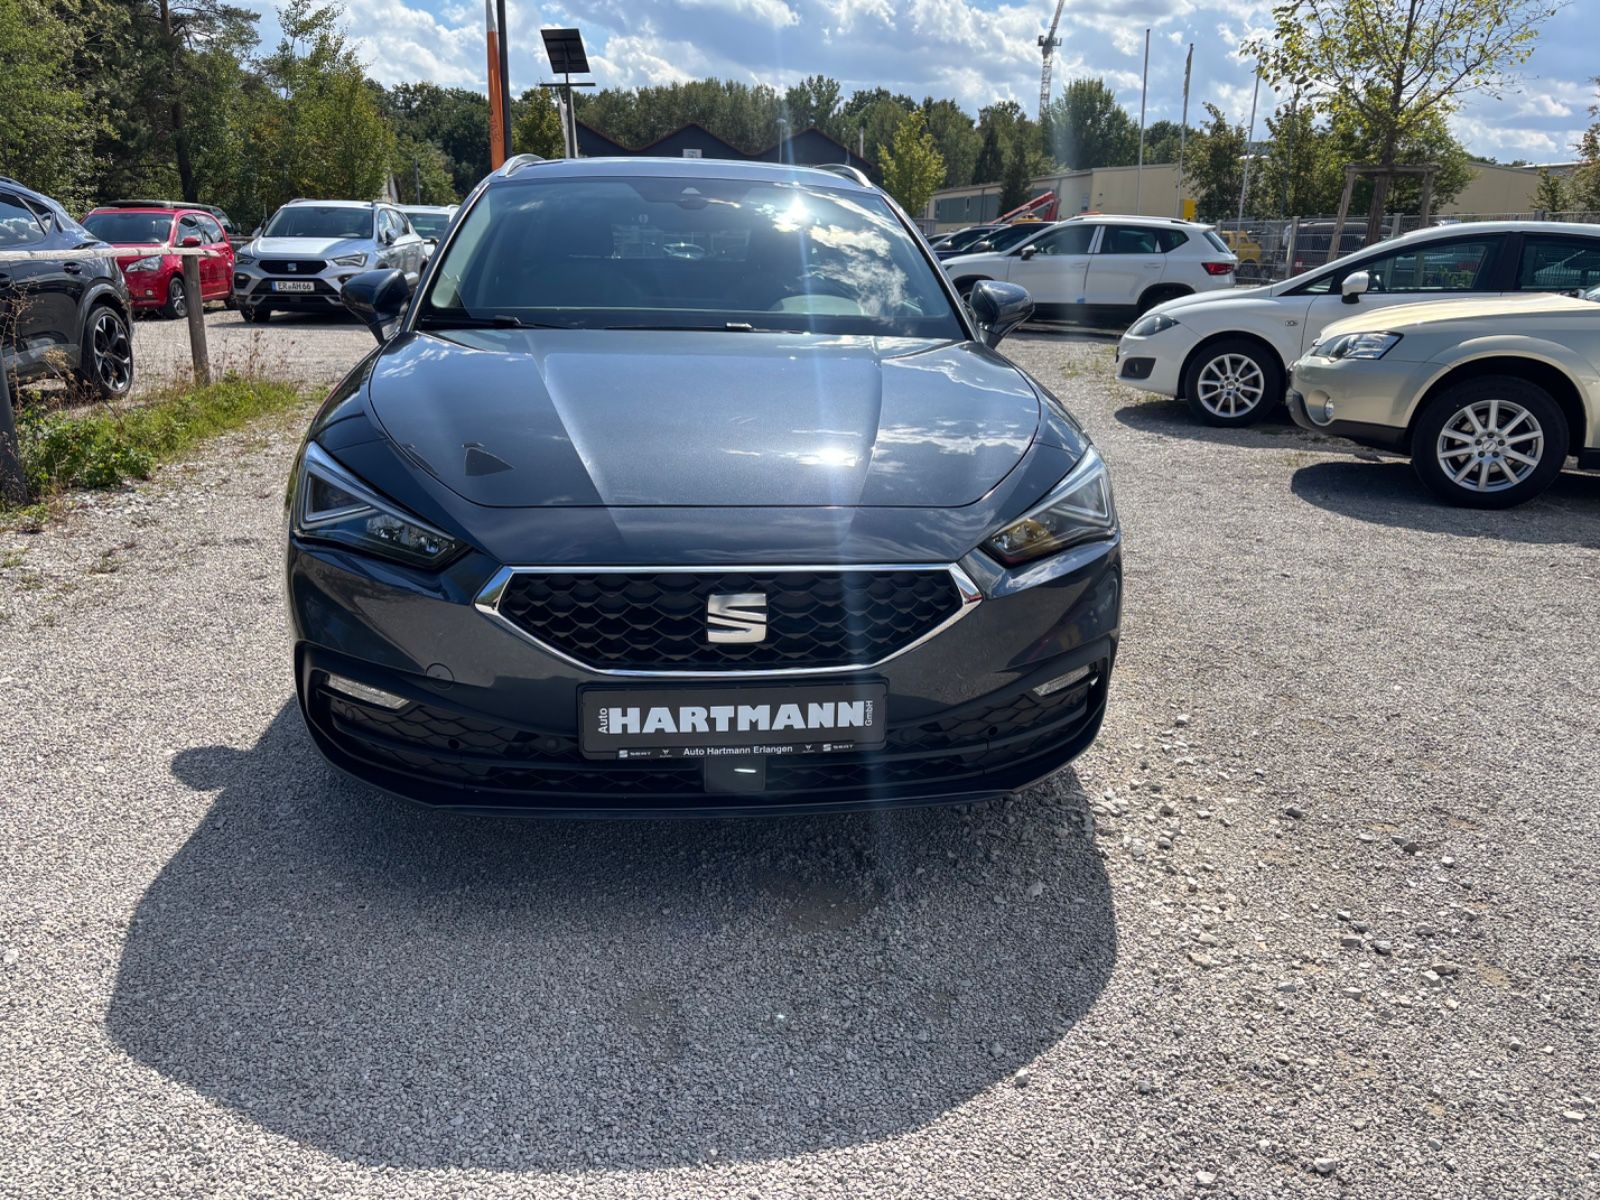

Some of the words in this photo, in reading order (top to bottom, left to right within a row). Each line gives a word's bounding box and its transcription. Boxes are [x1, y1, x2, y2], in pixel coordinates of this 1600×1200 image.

[278, 282, 288, 290] ER
[598, 707, 608, 734] Auto
[608, 701, 865, 734] HARTMANN
[865, 700, 873, 726] GmbH
[683, 747, 705, 756] Auto
[706, 747, 751, 756] Hartmann
[753, 745, 793, 755] Erlangen
